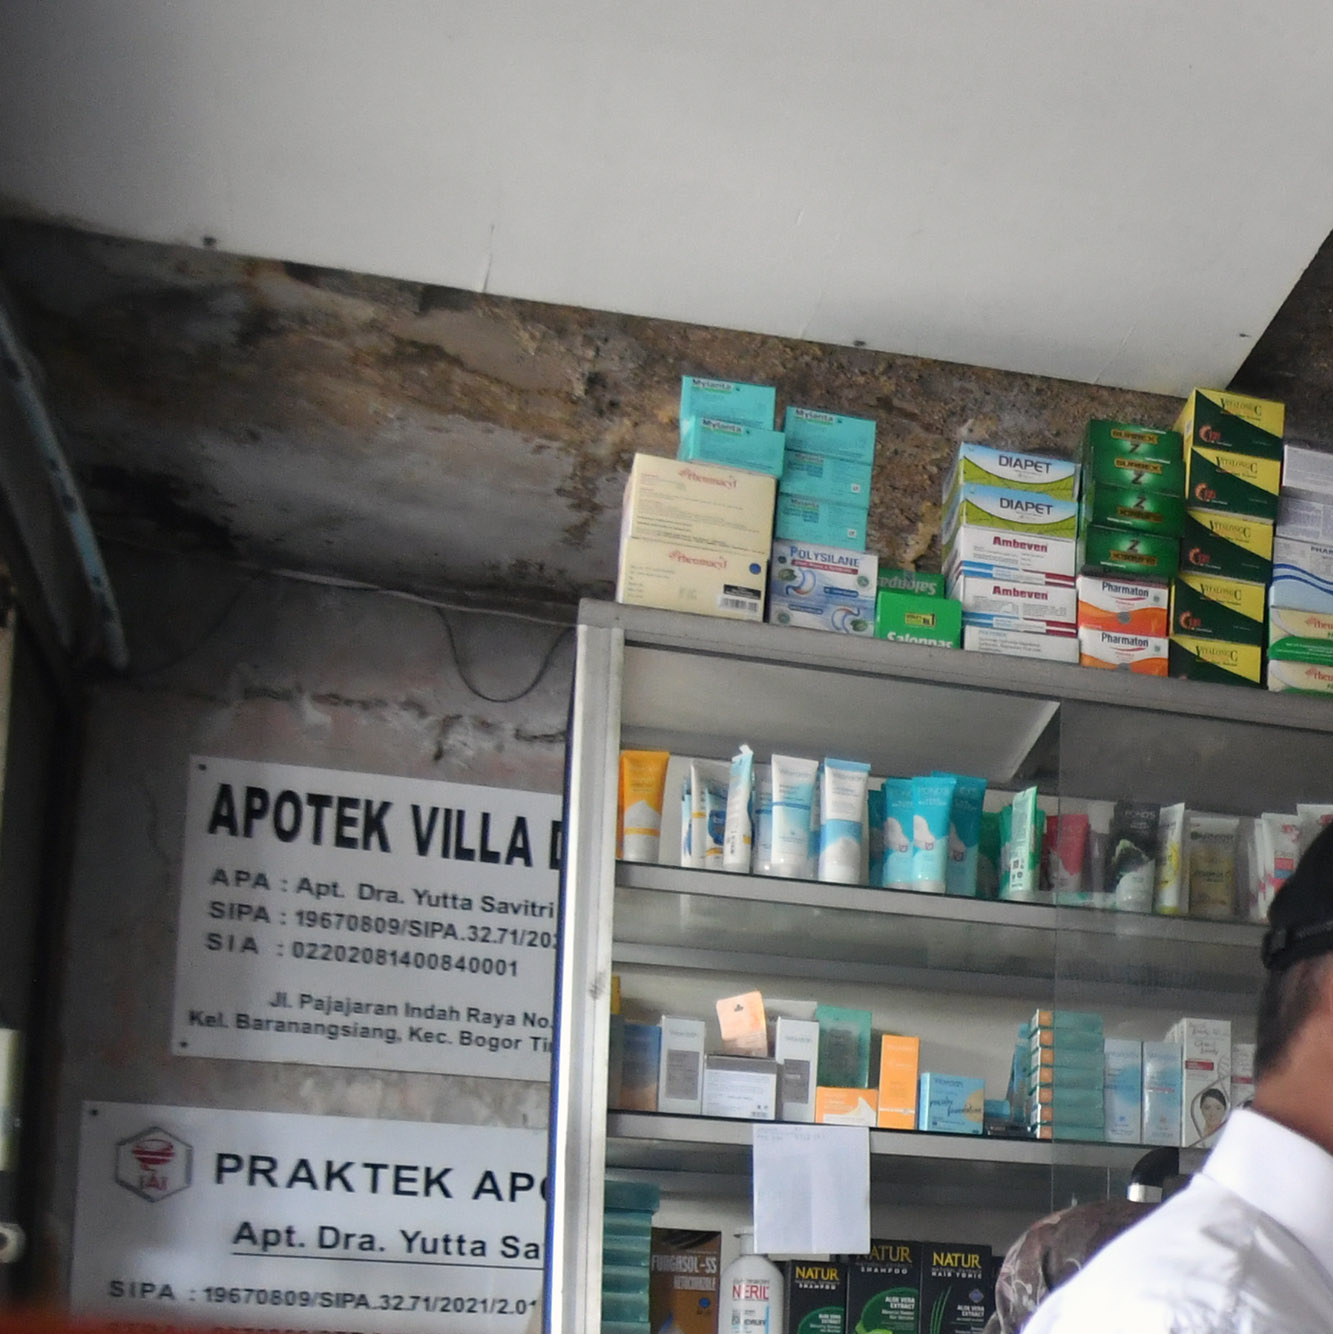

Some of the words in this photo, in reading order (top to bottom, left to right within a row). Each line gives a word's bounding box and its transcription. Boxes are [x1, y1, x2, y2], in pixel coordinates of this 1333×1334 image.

[998, 454, 1053, 476] DIAPET
[1000, 496, 1054, 518] DIAPET
[992, 535, 1048, 554] Ambeven
[790, 545, 860, 568] POLYSILANE
[992, 584, 1048, 601] Ambeven
[1101, 581, 1149, 598] Pharmaton
[1101, 632, 1149, 648] Pharmaton
[207, 782, 393, 853] APOTEK
[411, 803, 534, 868] VILLA
[211, 868, 271, 891] APA
[296, 877, 344, 901] Apt.
[358, 883, 405, 905] Dra.
[414, 889, 473, 911] Yutta
[480, 896, 555, 919] Savitri
[209, 901, 271, 924] SIPA
[291, 941, 519, 977] 02202081400840001
[299, 993, 398, 1021] Pajajaran
[404, 1002, 460, 1022] Indah
[466, 1007, 516, 1031] Raya
[523, 1012, 553, 1029] No.
[188, 1010, 229, 1030] Kel.
[235, 1014, 403, 1045] Baranangsiang,
[409, 1031, 453, 1047] Kec.
[459, 1032, 523, 1054] Bogor
[214, 1152, 454, 1199] PRAKTEK
[232, 1222, 304, 1252] Apt.
[318, 1226, 385, 1252] Dra.
[399, 1229, 487, 1258] Yutta
[861, 1266, 908, 1275] SHAMPOO
[932, 1252, 982, 1269] NATUR
[795, 1265, 840, 1281] NATUR
[109, 1280, 174, 1300] SIPA
